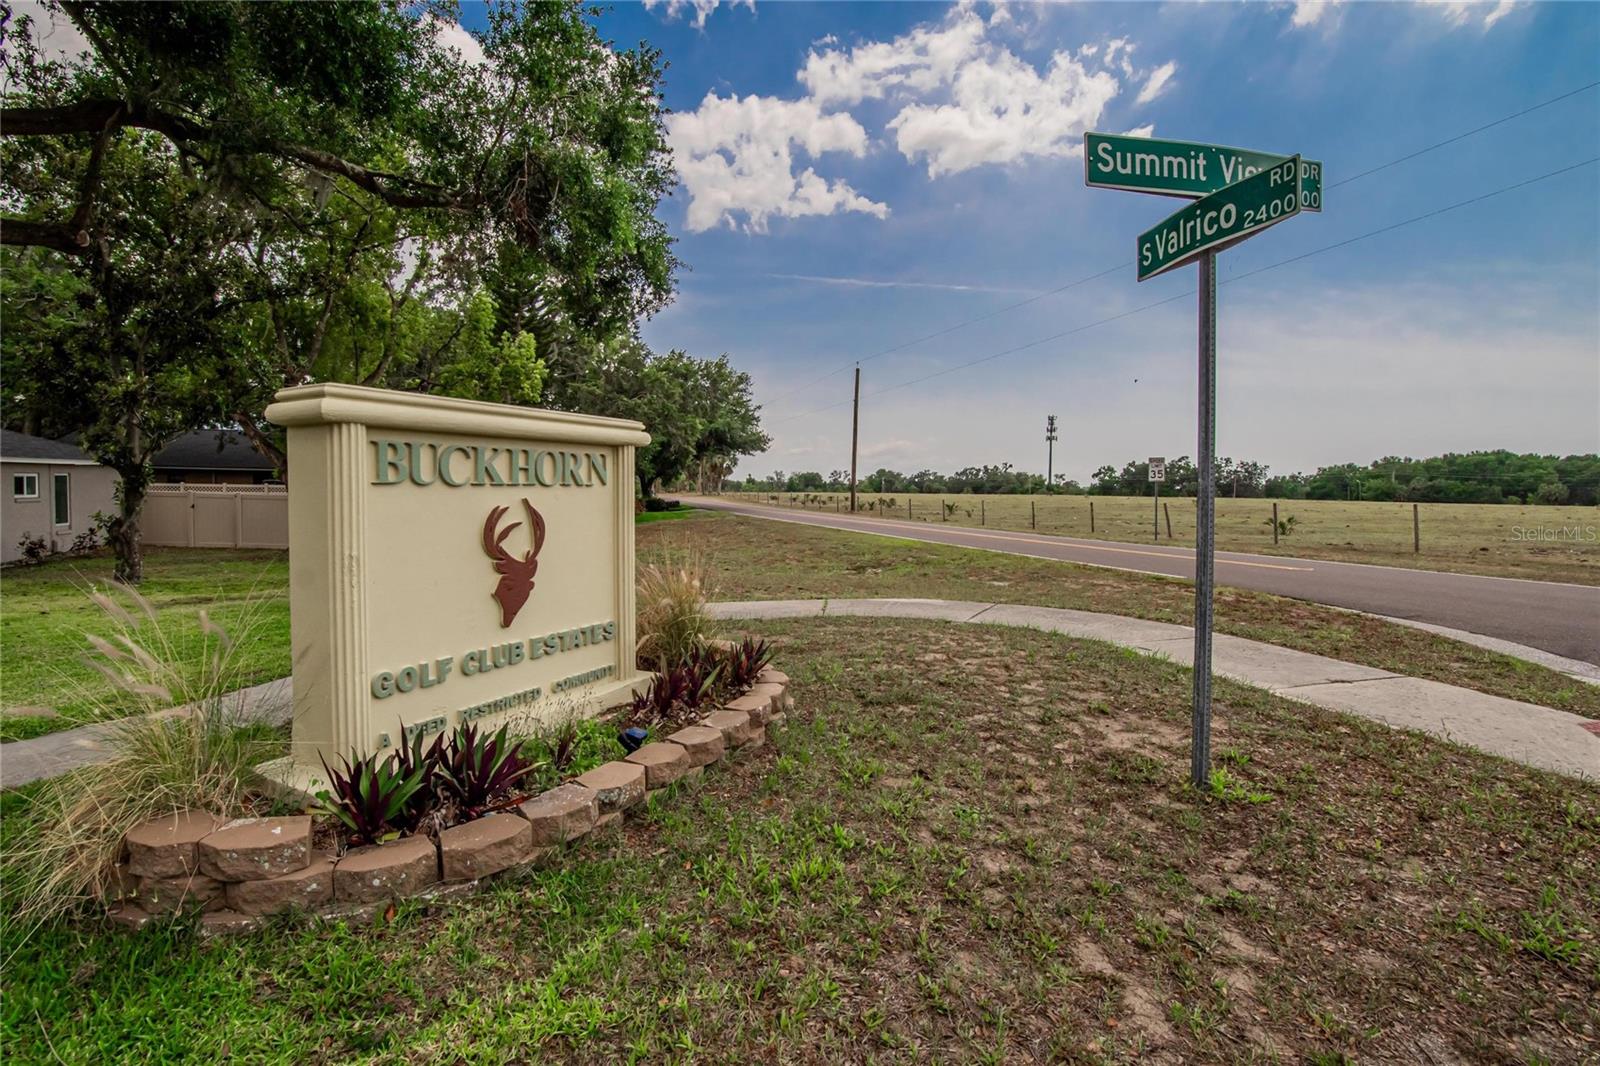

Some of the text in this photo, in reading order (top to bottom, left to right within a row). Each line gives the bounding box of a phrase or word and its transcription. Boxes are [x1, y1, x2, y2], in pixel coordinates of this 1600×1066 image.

[1097, 142, 1320, 184] Summit Vie DR
[1142, 162, 1295, 266] S Valrico RD
[1243, 193, 1296, 229] 2400
[369, 439, 608, 488] BUCKHORN
[1150, 469, 1163, 479] 35
[370, 620, 617, 700] GOLF CLUB ESTATES
[378, 732, 392, 749] A
[457, 686, 543, 724] RESTRICTED
